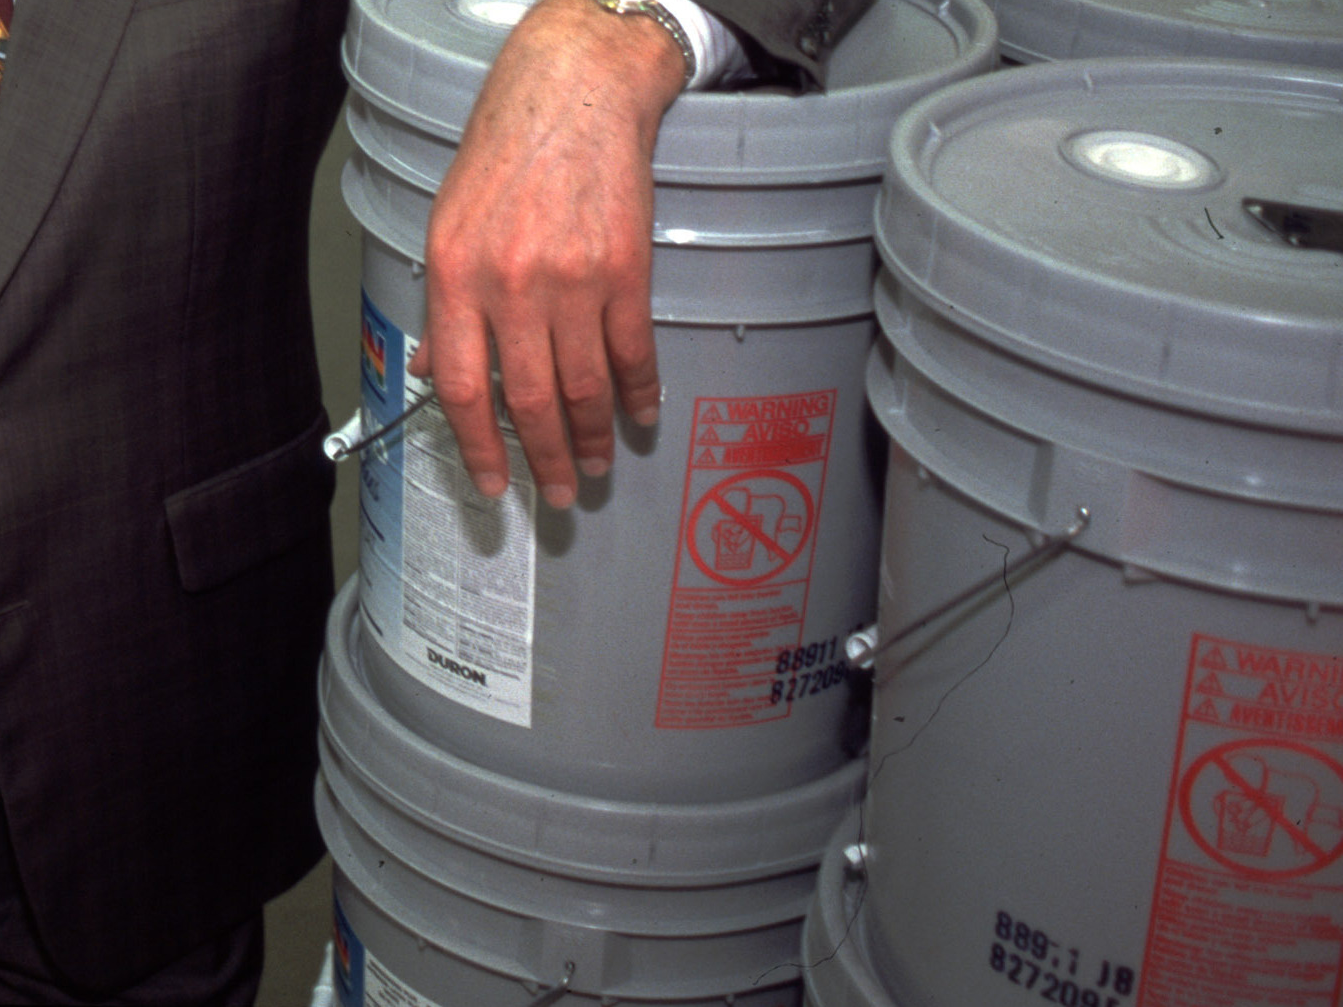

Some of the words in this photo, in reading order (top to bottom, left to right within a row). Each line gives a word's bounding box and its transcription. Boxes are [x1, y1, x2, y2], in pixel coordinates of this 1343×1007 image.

[726, 395, 830, 421] WARNING
[741, 419, 810, 444] AVISO
[426, 646, 487, 687] DURON
[776, 636, 837, 673] 88911
[1237, 649, 1343, 684] WARNI
[770, 660, 850, 704] 827209
